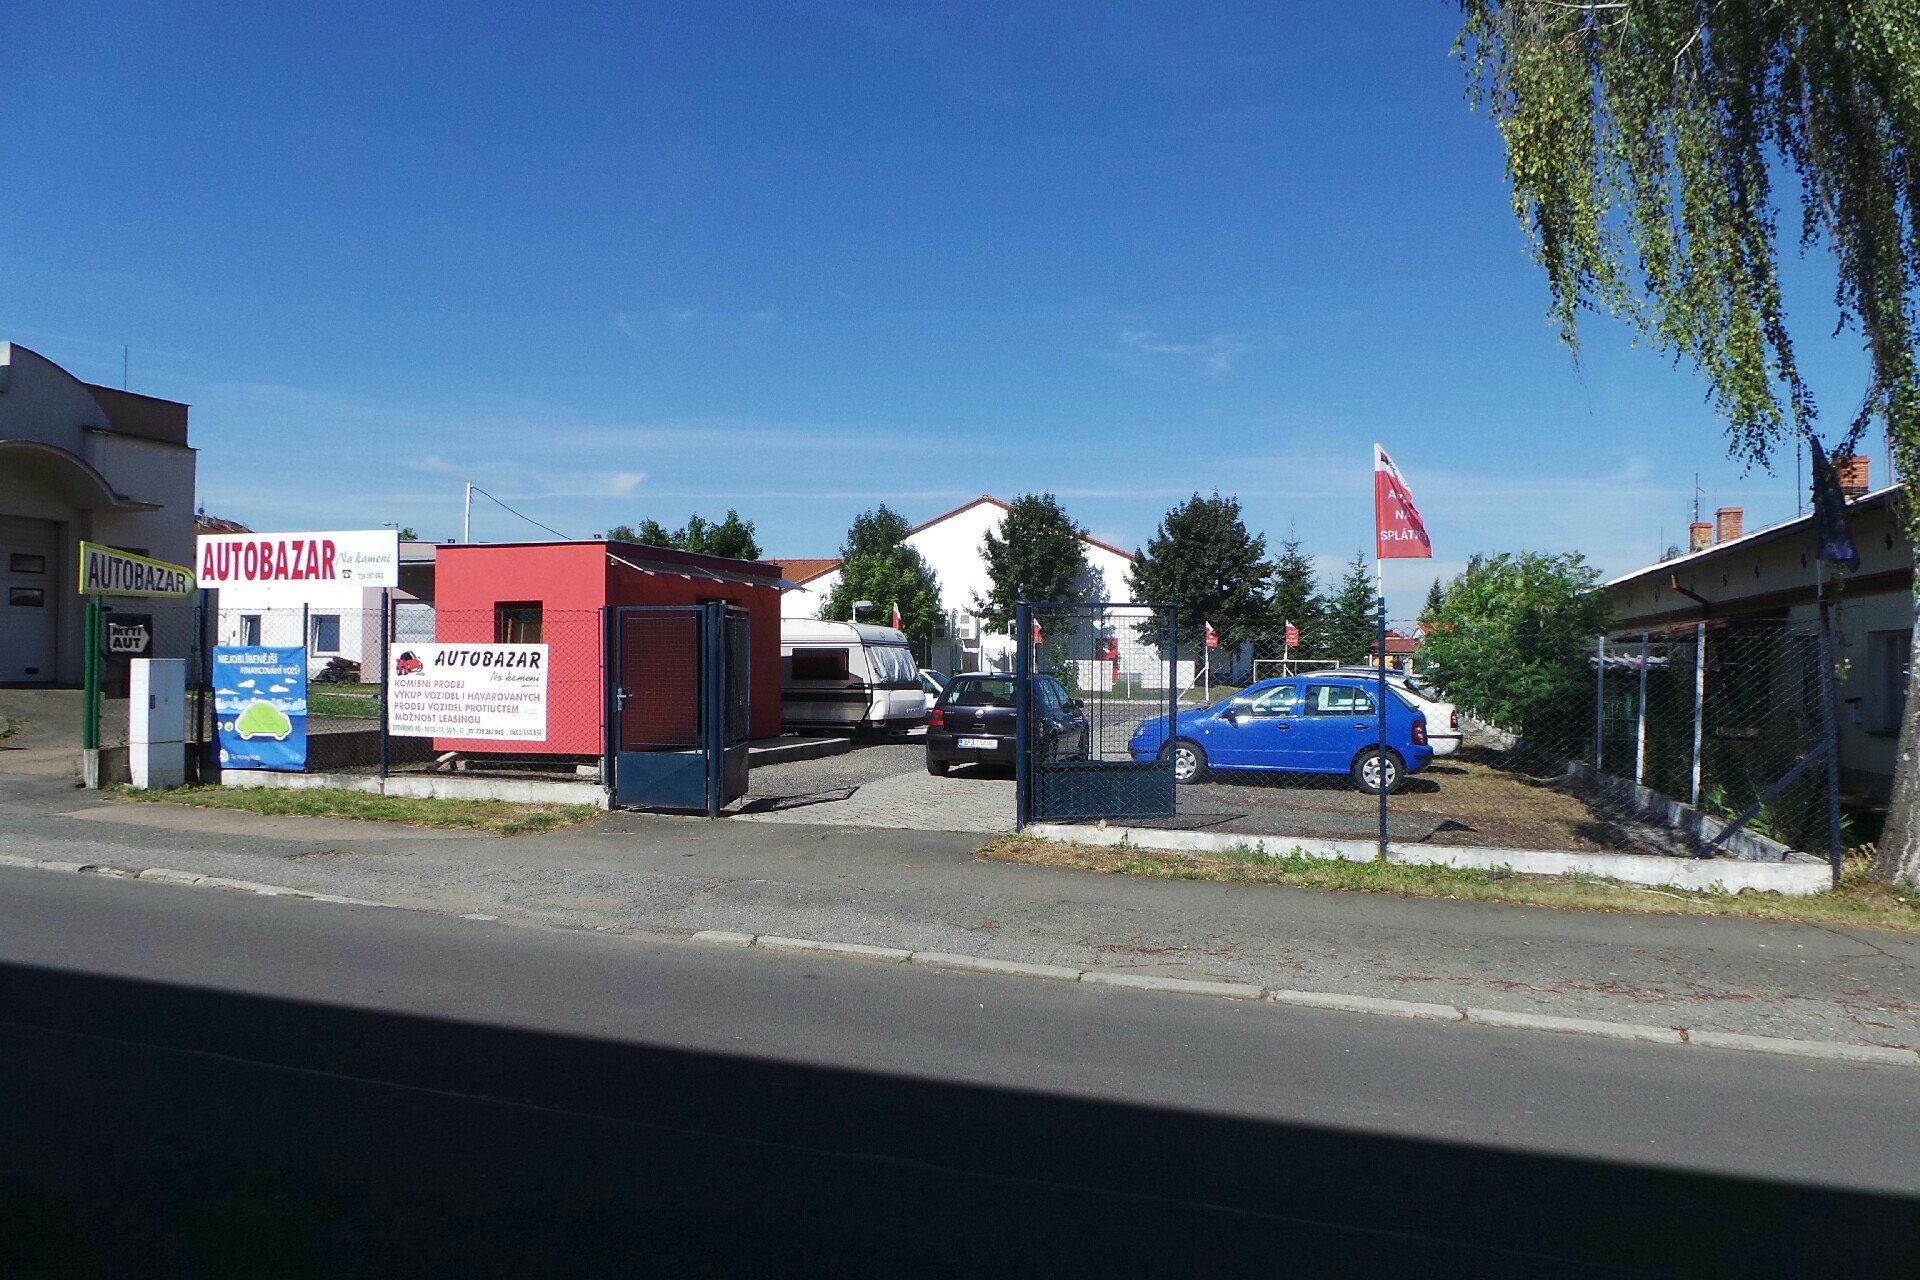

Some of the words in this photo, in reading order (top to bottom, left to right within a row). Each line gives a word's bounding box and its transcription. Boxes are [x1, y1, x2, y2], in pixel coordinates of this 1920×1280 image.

[201, 540, 336, 581] AUTOBAZAR
[335, 551, 352, 566] Na
[88, 552, 186, 593] AUTOBAZAR
[112, 637, 141, 649] AUT
[217, 652, 278, 664] NEJOBLÍBENĚJŠÍ
[434, 650, 541, 669] AUTOBAZAR
[490, 670, 503, 682] Na
[394, 678, 432, 688] KOMISNÍ
[433, 680, 465, 689] PRODEJ
[424, 691, 459, 700] VOZIDEL
[394, 702, 425, 711] PRODEJ
[427, 702, 463, 712] VOZIDEL
[394, 711, 436, 722] MOŽNOST
[438, 714, 481, 724] LEASINGU
